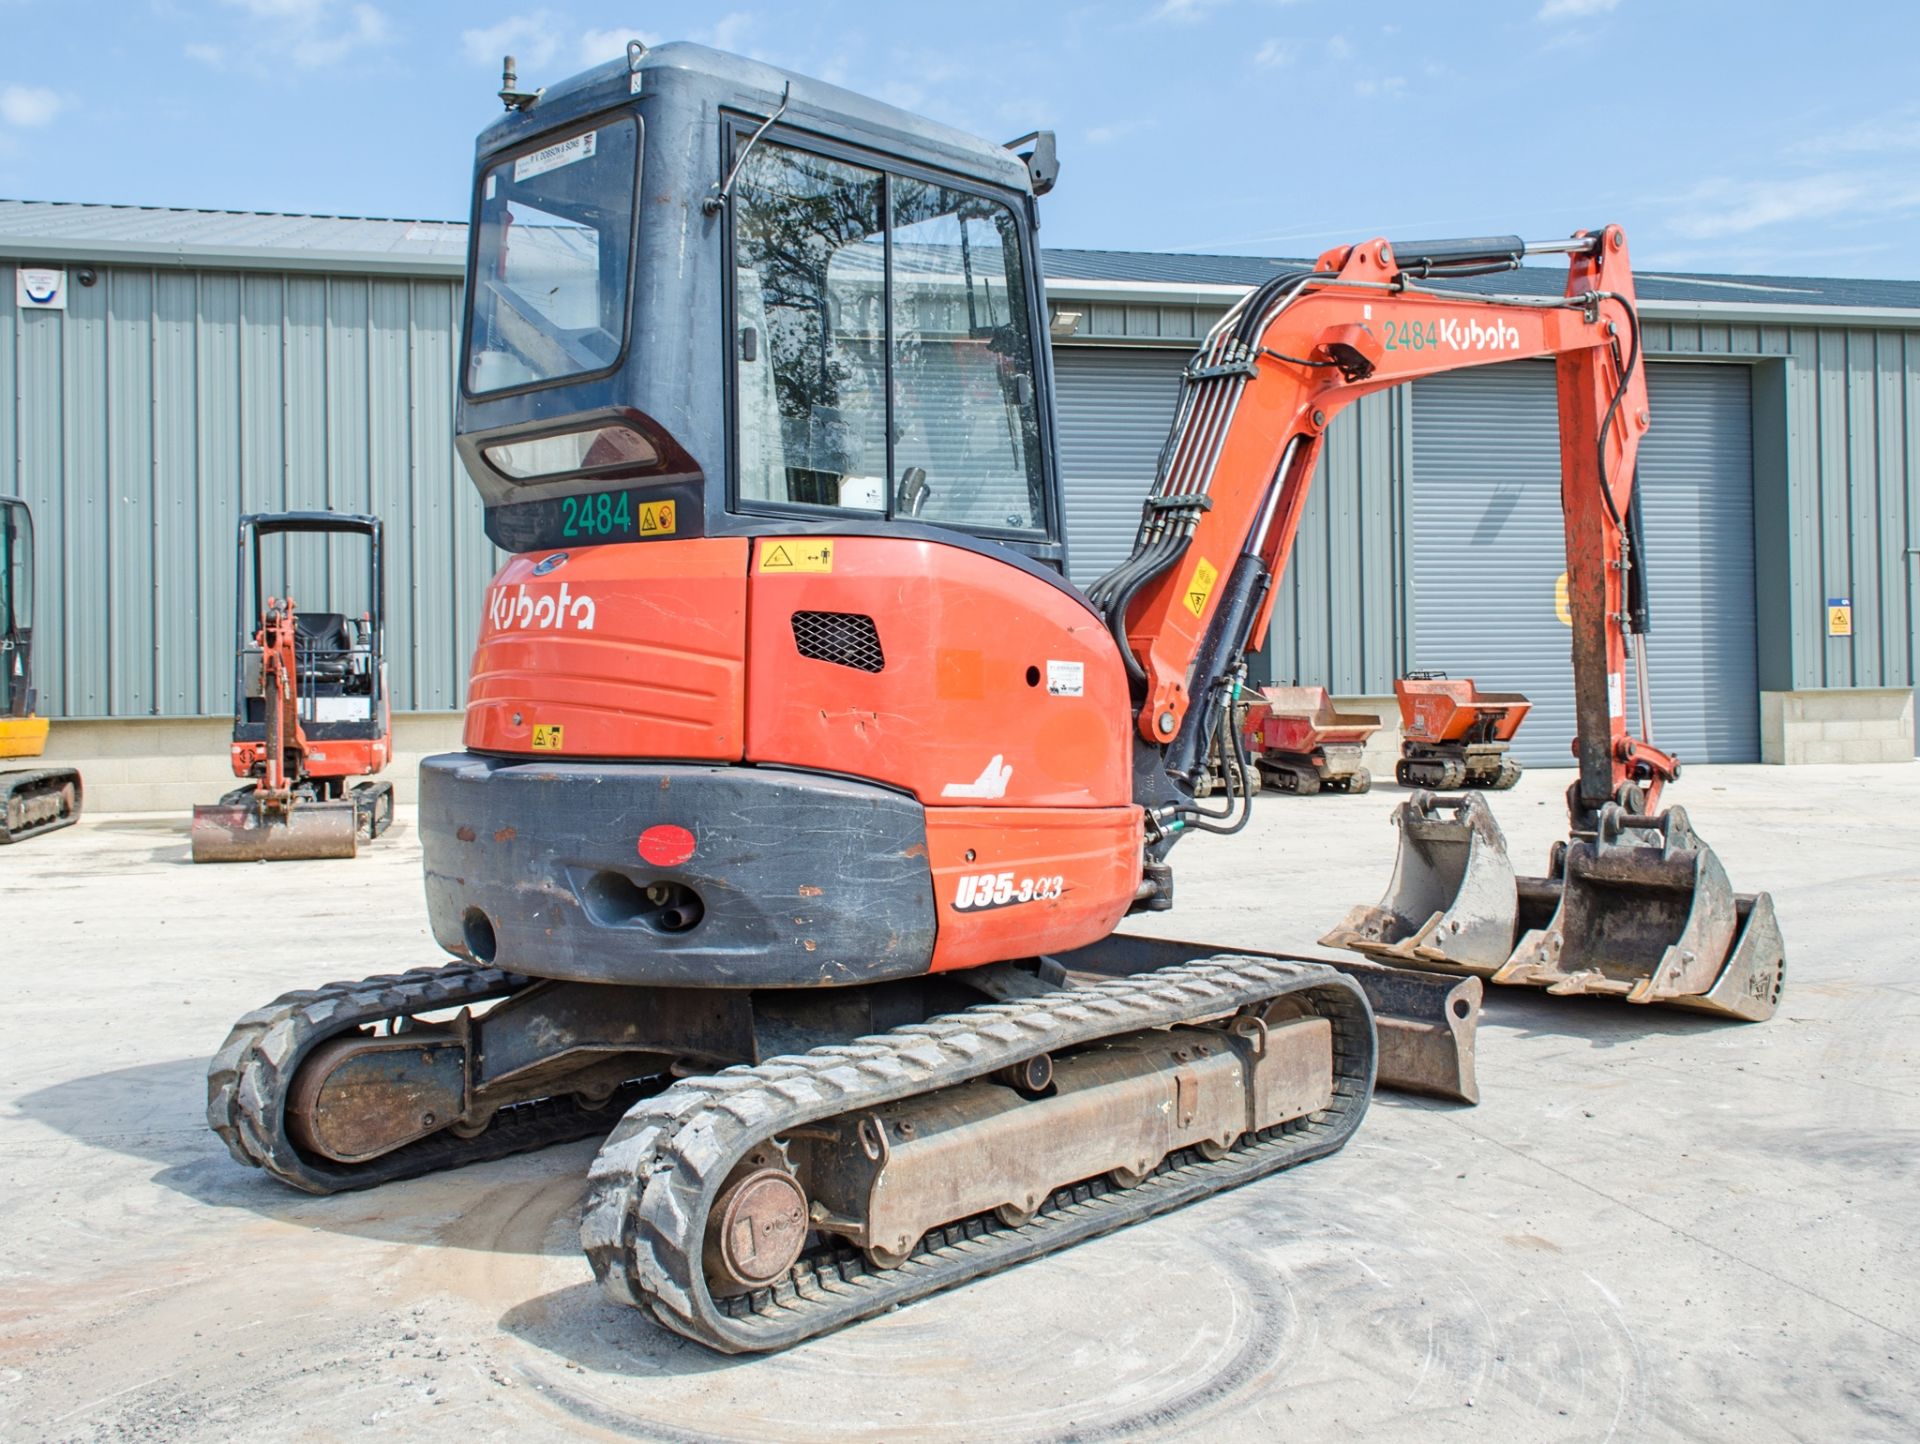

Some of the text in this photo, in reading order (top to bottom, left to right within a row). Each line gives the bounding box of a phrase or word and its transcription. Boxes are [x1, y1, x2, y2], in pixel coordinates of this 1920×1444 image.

[1384, 318, 1520, 351] 2484 Kubota
[562, 489, 631, 537] 2484
[489, 582, 596, 630] Kubota
